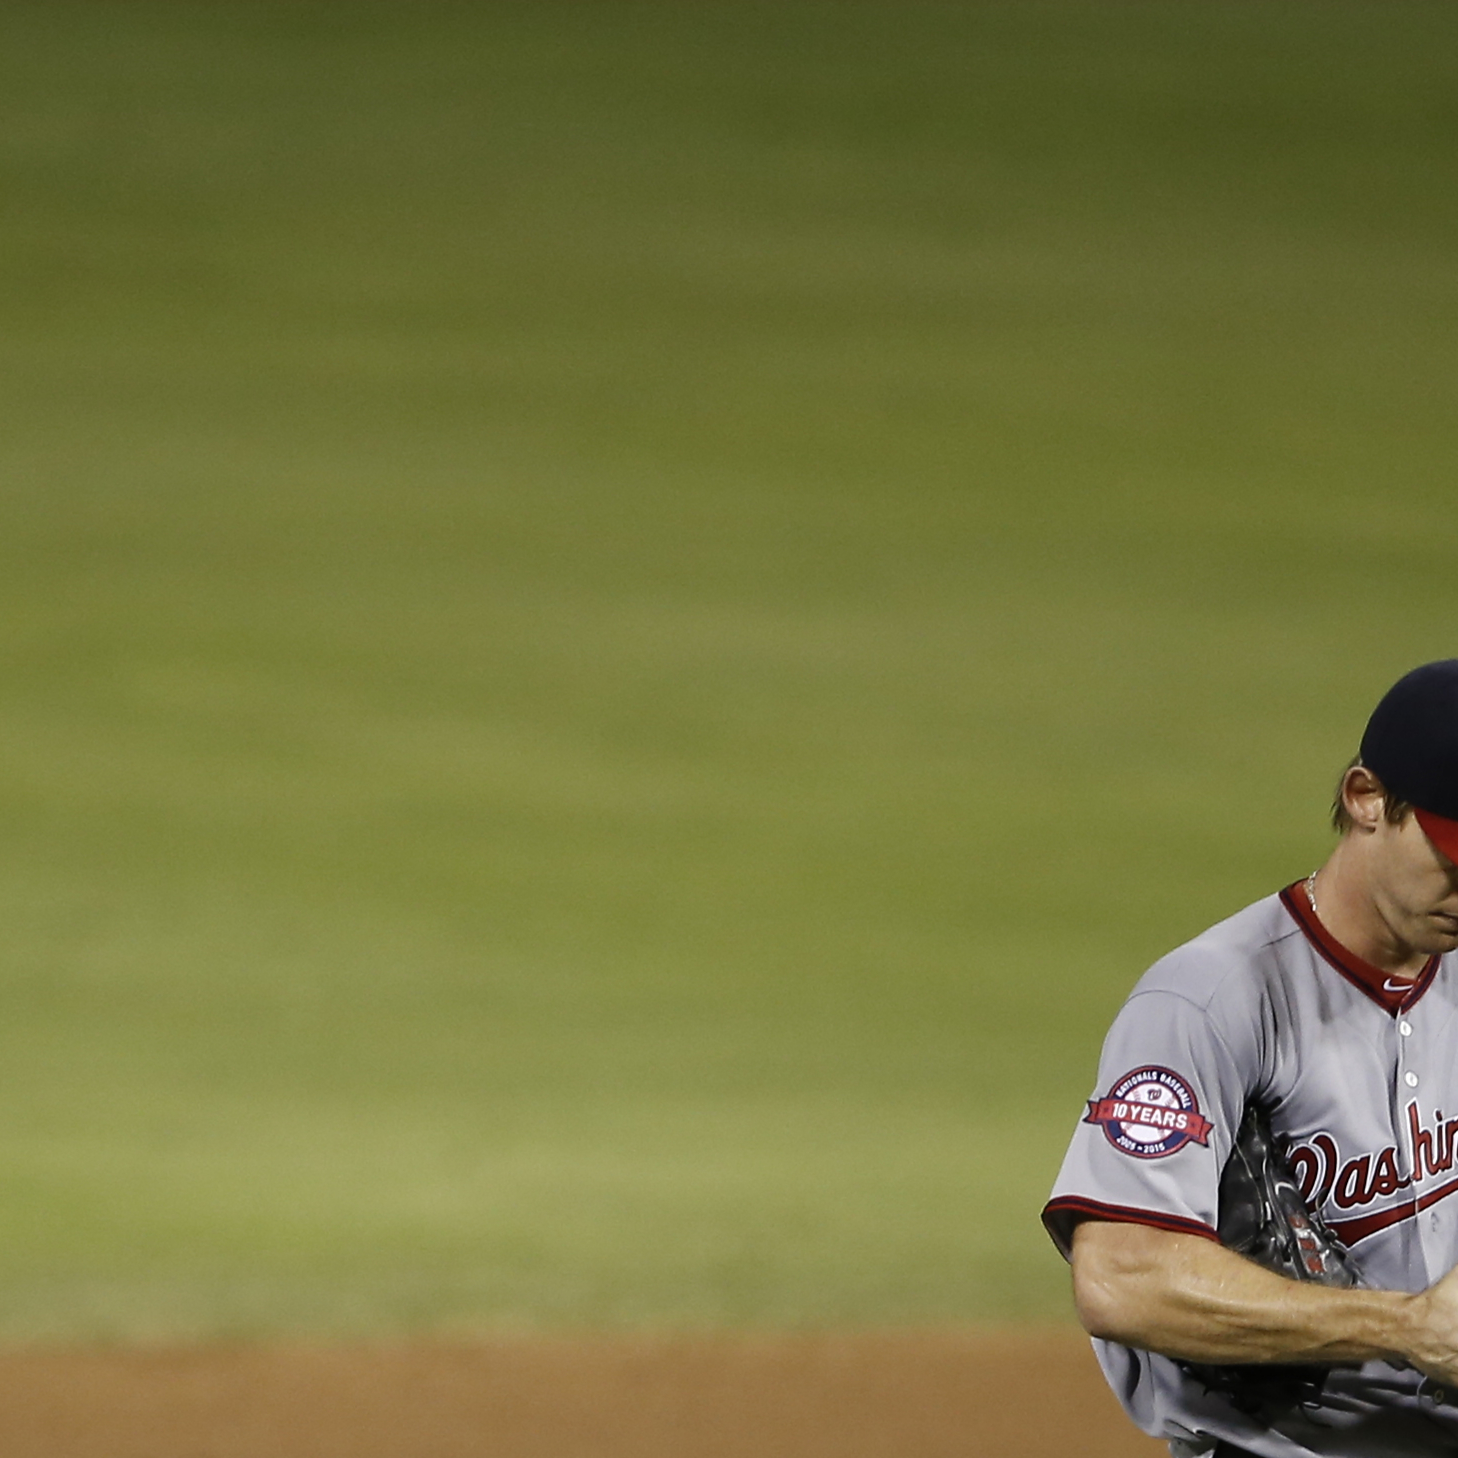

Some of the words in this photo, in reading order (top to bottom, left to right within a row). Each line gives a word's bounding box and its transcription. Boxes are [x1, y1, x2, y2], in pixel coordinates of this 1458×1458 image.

[1115, 1071, 1158, 1098] NATIONALS
[1160, 1073, 1192, 1109] BASEBALL
[1112, 1102, 1128, 1118] 10
[1130, 1104, 1188, 1130] YEARS
